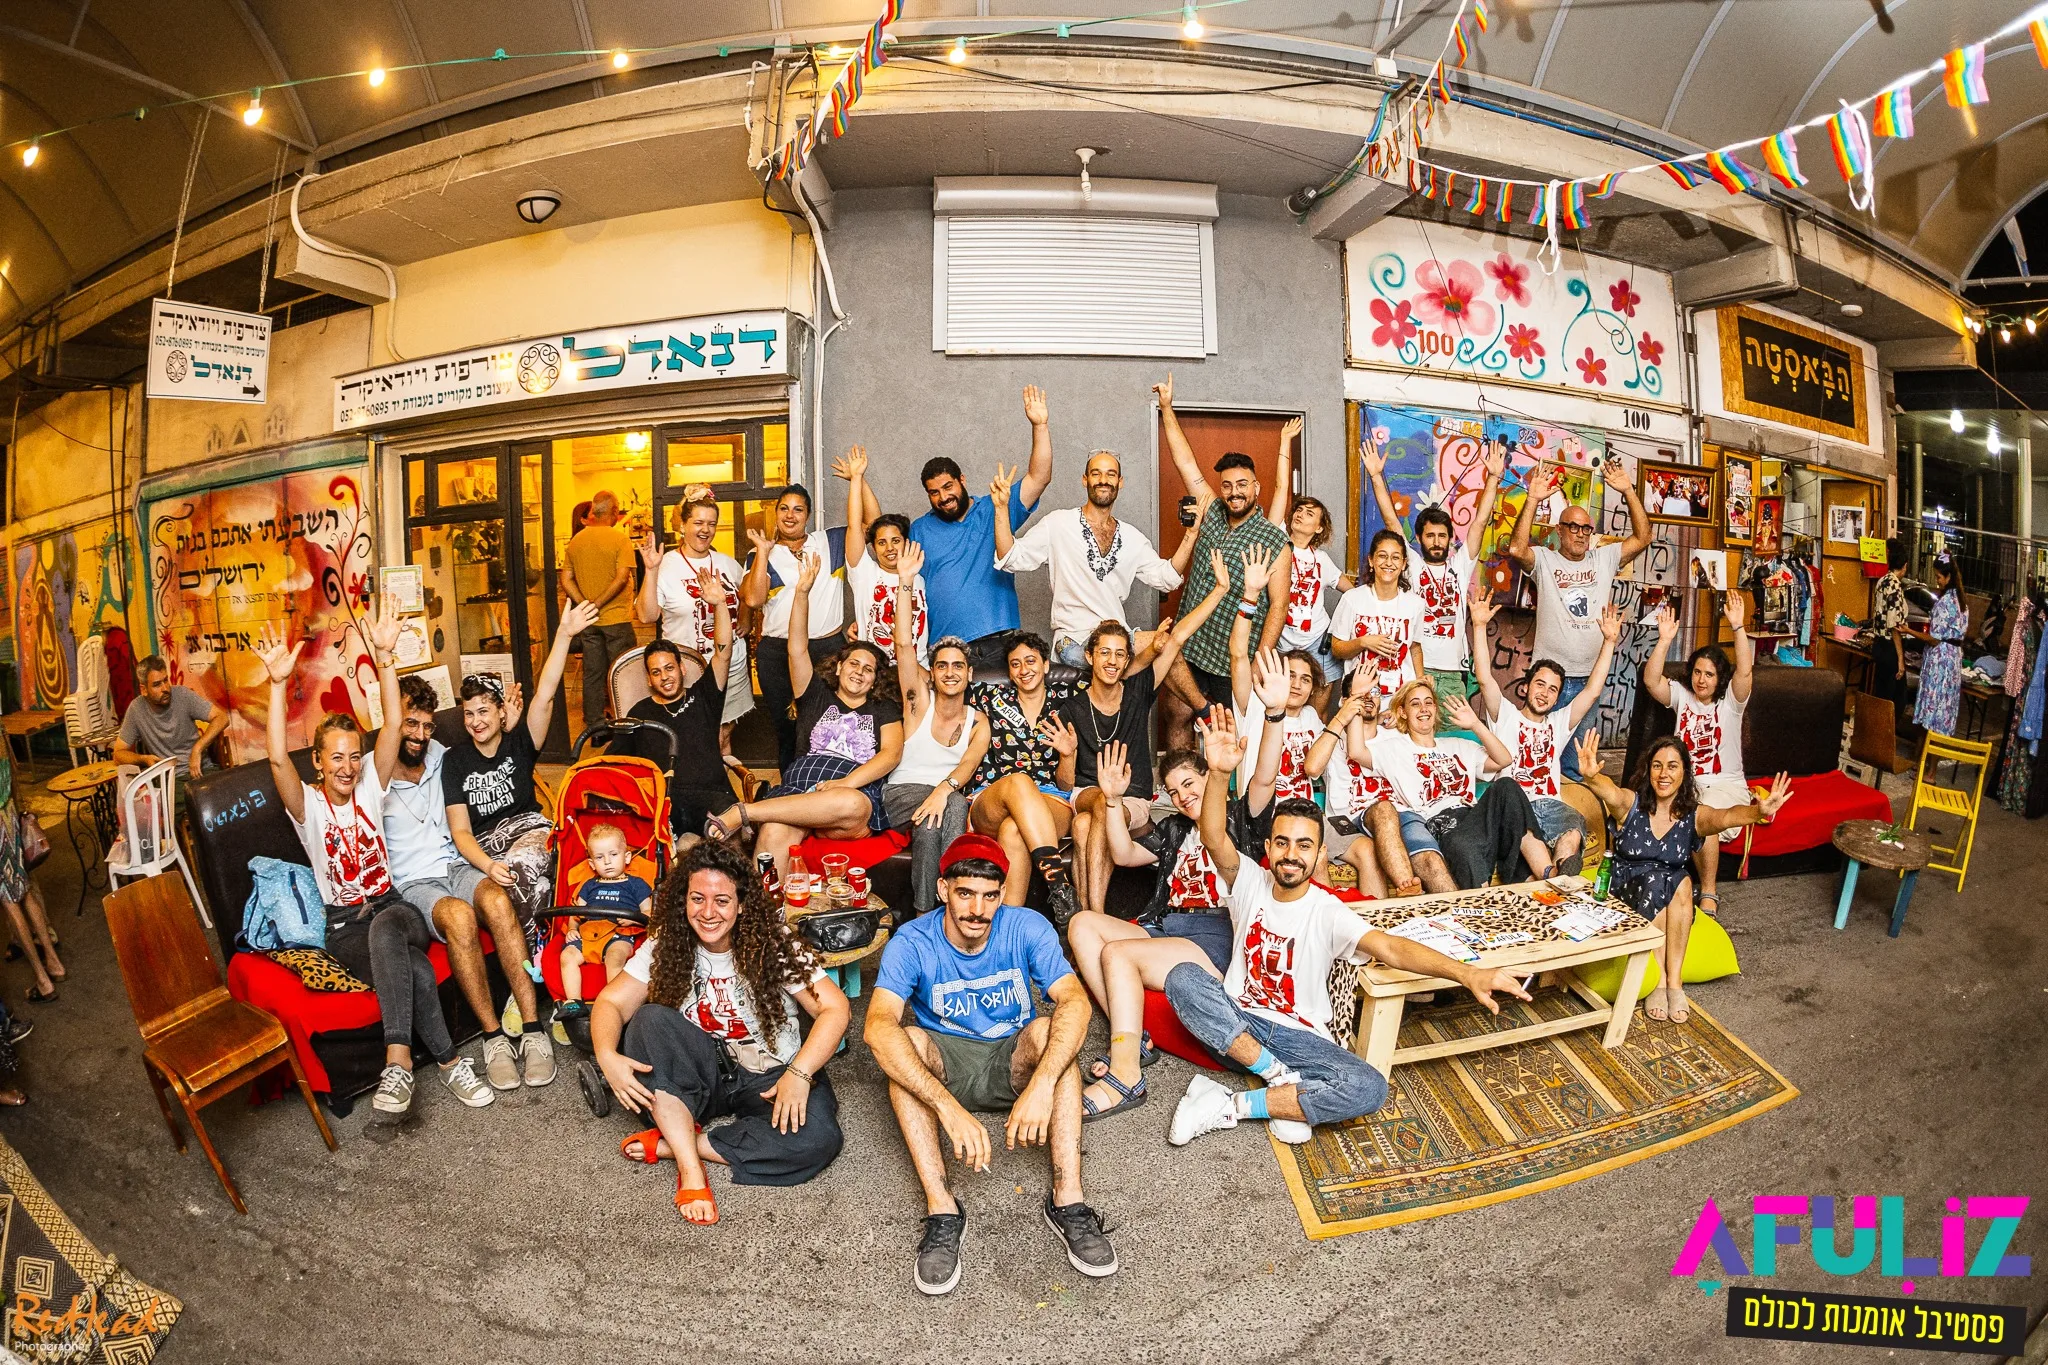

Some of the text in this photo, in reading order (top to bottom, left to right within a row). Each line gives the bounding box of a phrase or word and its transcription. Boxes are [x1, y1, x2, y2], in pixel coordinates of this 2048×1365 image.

[159, 311, 267, 341] צורפות ויודאיקה
[1418, 329, 1454, 356] 100
[341, 351, 513, 402] צורפות ויודאיקה
[392, 400, 401, 411] יד
[402, 393, 434, 411] בעבודת
[437, 387, 472, 404] מקוריים
[1622, 408, 1651, 431] 100
[211, 523, 252, 548] אתכם
[257, 508, 339, 543] השבעתי
[178, 555, 265, 590] ירושלים
[203, 631, 252, 653] אהבה
[1000, 706, 1023, 726] AFULA
[468, 774, 492, 789] REAL
[495, 777, 515, 799] BUY
[476, 792, 515, 816] WOMEN
[1496, 932, 1525, 942] AFULA
